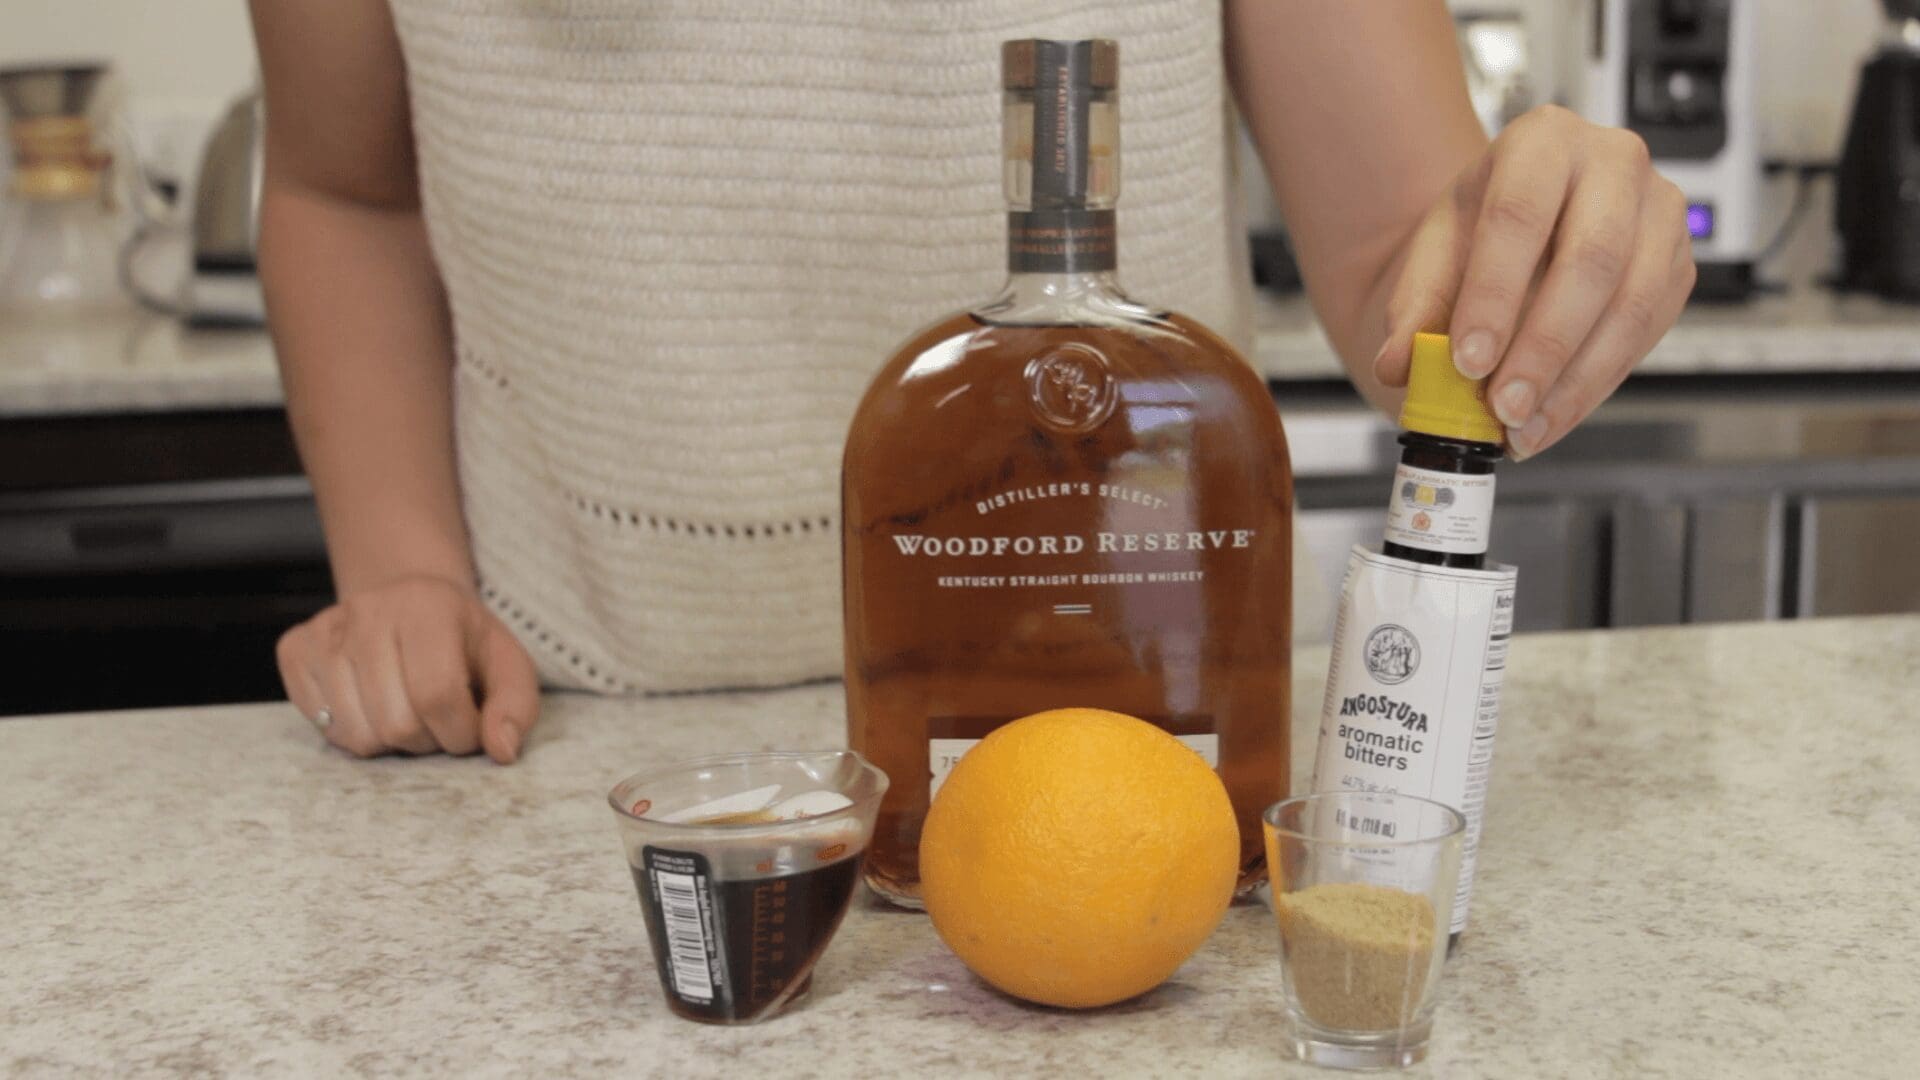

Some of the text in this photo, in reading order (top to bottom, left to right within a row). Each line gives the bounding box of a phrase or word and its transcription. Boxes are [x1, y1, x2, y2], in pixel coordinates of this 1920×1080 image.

[977, 482, 1162, 515] DISTILLER'S SELECT
[893, 529, 1250, 556] WOODFORD RESERVE
[938, 571, 1204, 587] KENTUCKY STRAIGHT BOURBON WHISKEY
[1339, 693, 1428, 733] ANGOSTURA
[1338, 723, 1424, 754] aromatic
[1345, 741, 1408, 771] bitters
